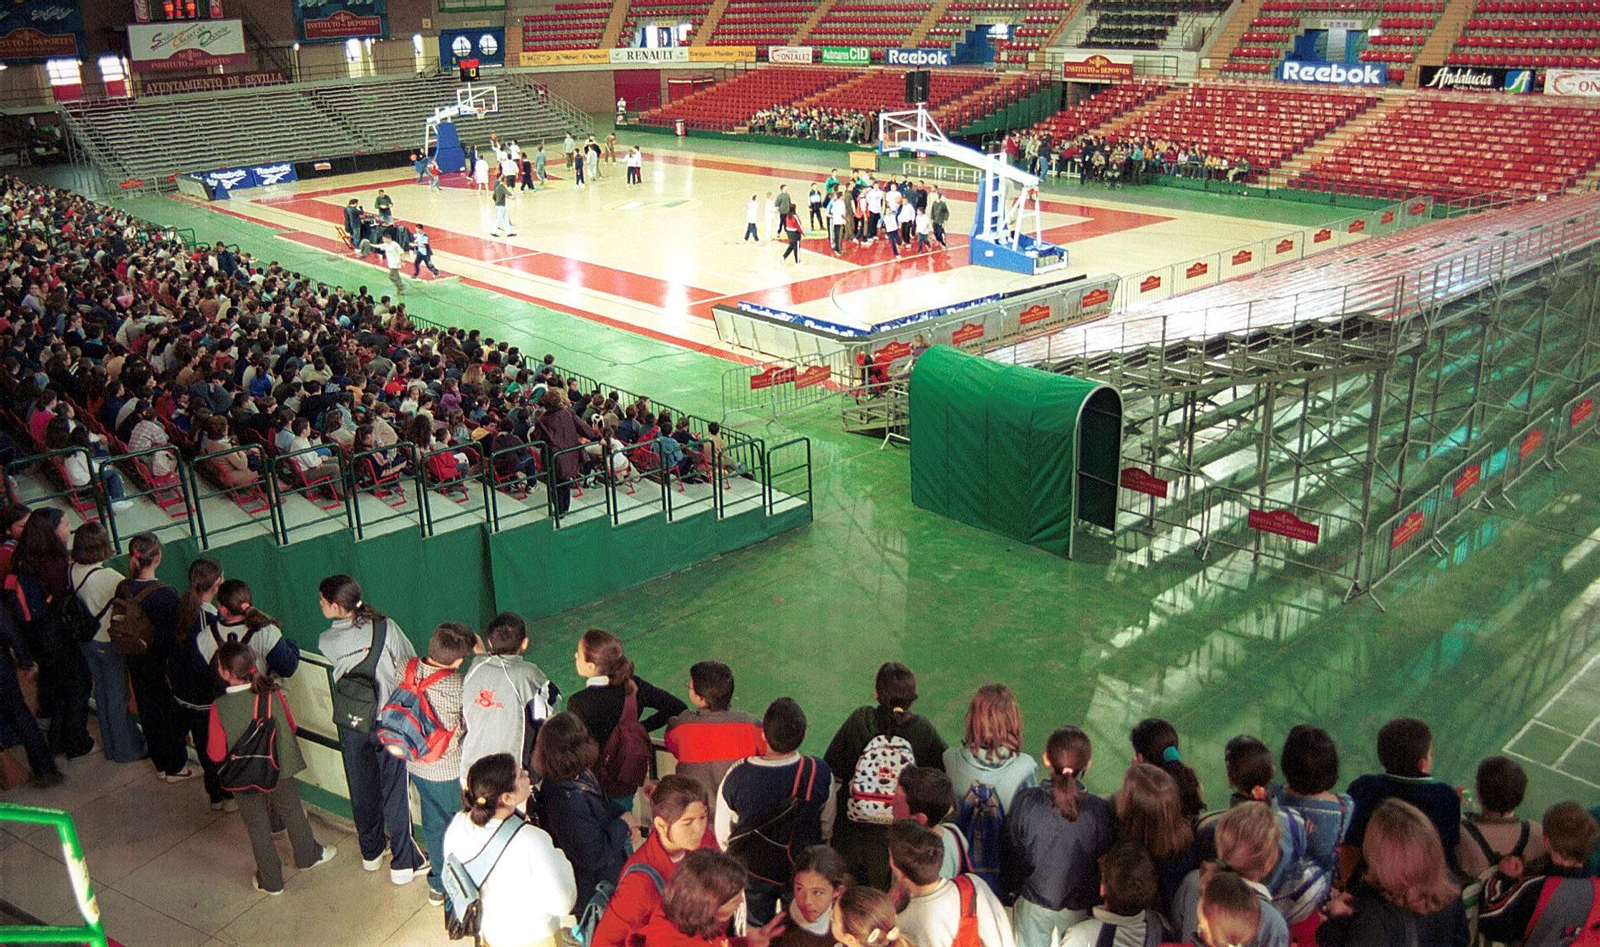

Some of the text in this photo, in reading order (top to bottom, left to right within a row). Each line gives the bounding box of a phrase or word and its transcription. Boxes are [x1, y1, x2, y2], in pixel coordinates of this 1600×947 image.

[627, 51, 674, 60] RENAULT
[850, 47, 869, 60] CID
[888, 49, 948, 66] Reebok
[1283, 61, 1380, 84] Reebok
[146, 73, 284, 94] AYUNTAMIENTO DE SEVILLA
